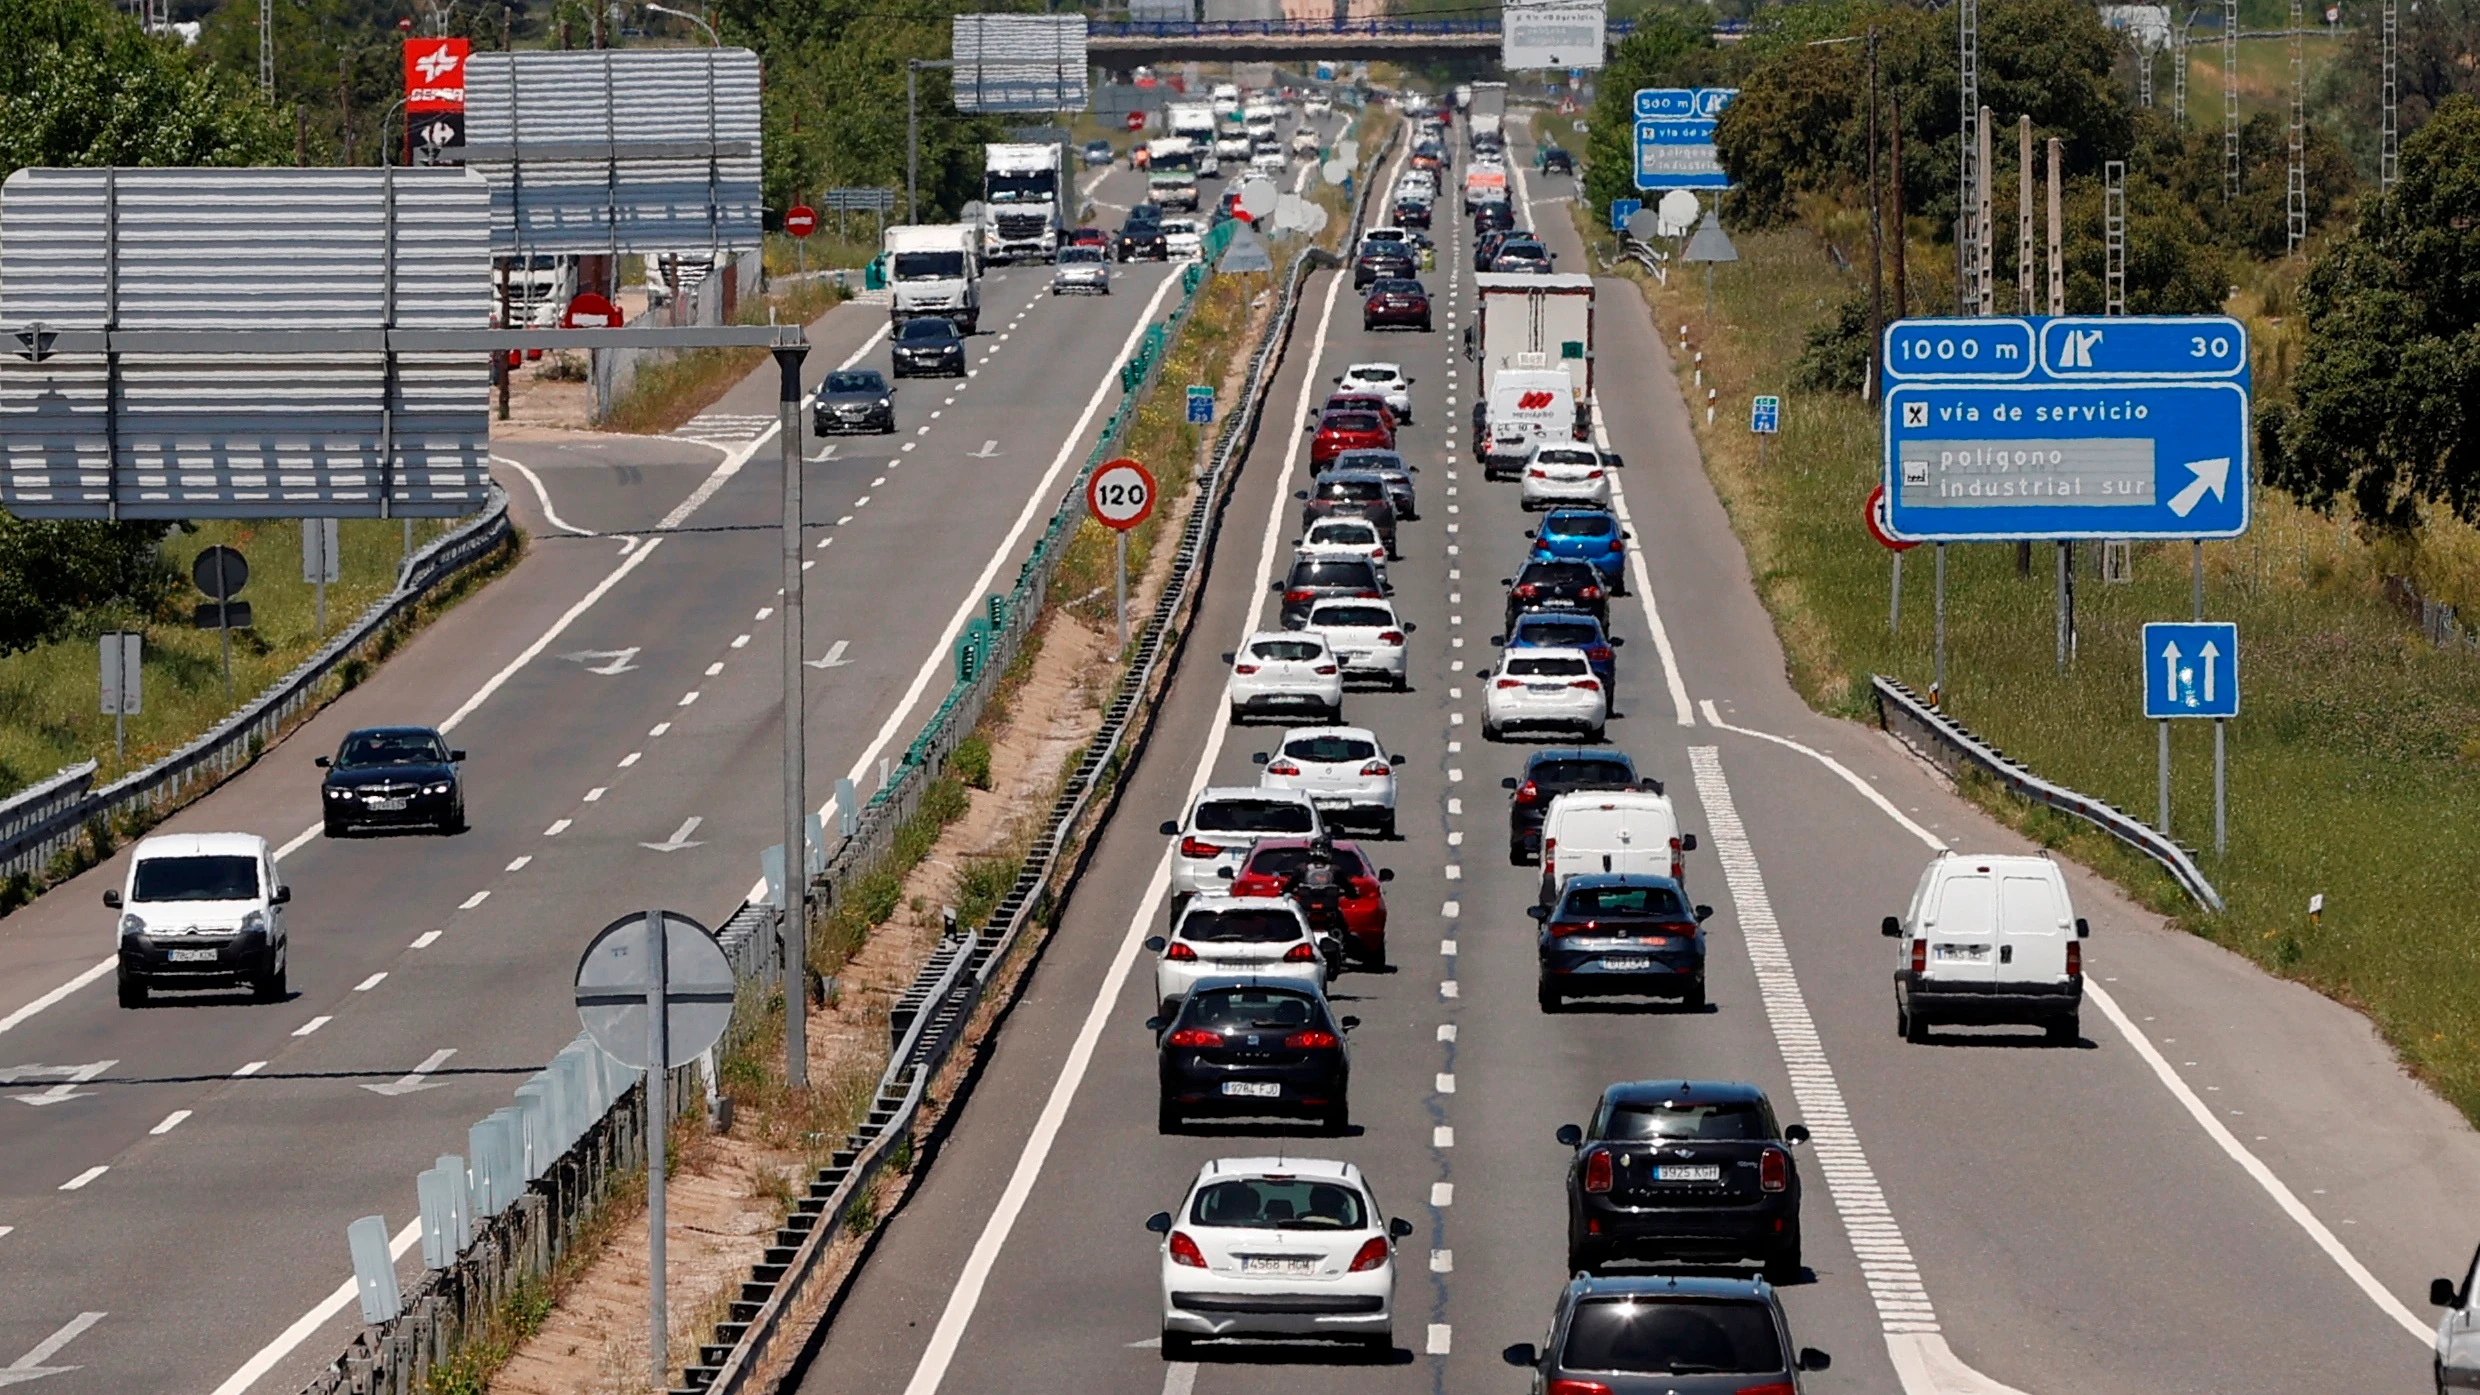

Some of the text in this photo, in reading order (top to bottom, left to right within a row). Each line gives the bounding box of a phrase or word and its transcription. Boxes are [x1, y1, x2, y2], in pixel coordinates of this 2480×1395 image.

[1641, 97, 1688, 109] 500 m
[1902, 338, 2019, 360] 1000 m
[2190, 336, 2229, 358] 30
[1940, 400, 2149, 422] vía de servicio
[1940, 447, 2062, 472] polígono
[1099, 483, 1145, 506] 120
[1940, 477, 2145, 498] industrial sur
